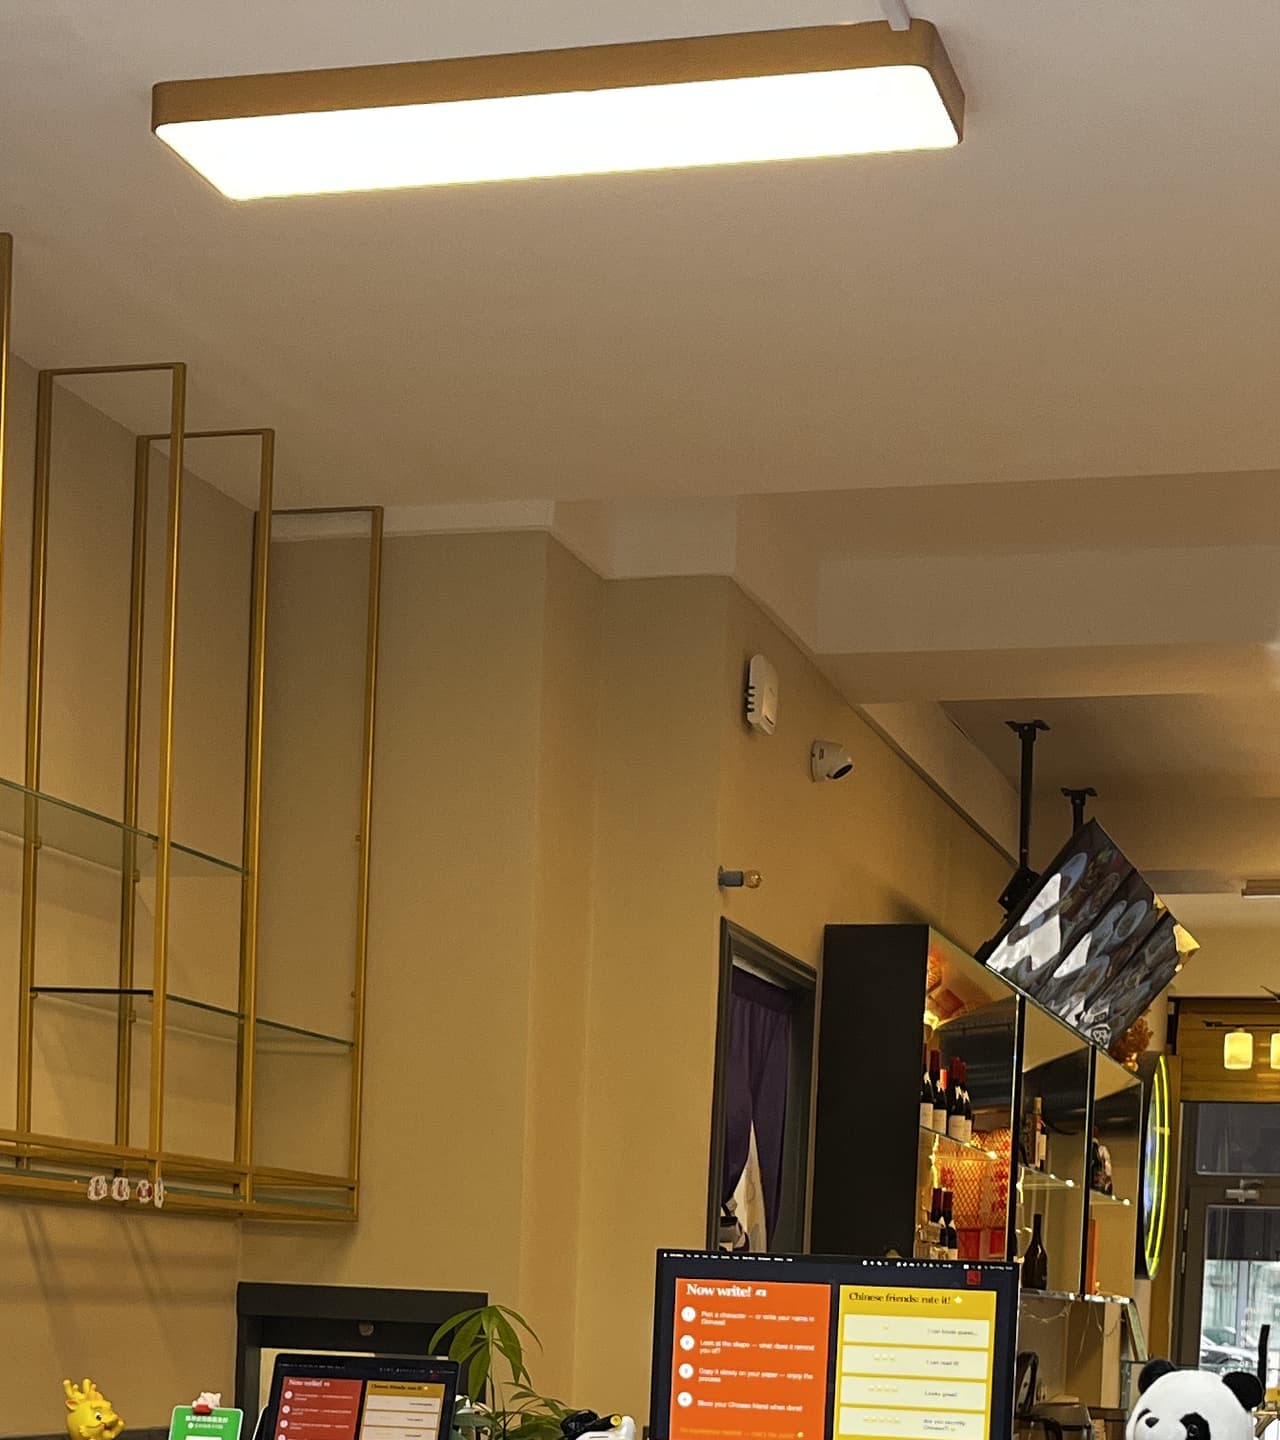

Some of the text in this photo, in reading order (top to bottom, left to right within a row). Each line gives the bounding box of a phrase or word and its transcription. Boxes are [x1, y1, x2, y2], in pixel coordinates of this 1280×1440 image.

[686, 1284, 752, 1297] Now write!
[848, 1292, 882, 1302] Chinese
[886, 1293, 918, 1303] friends:
